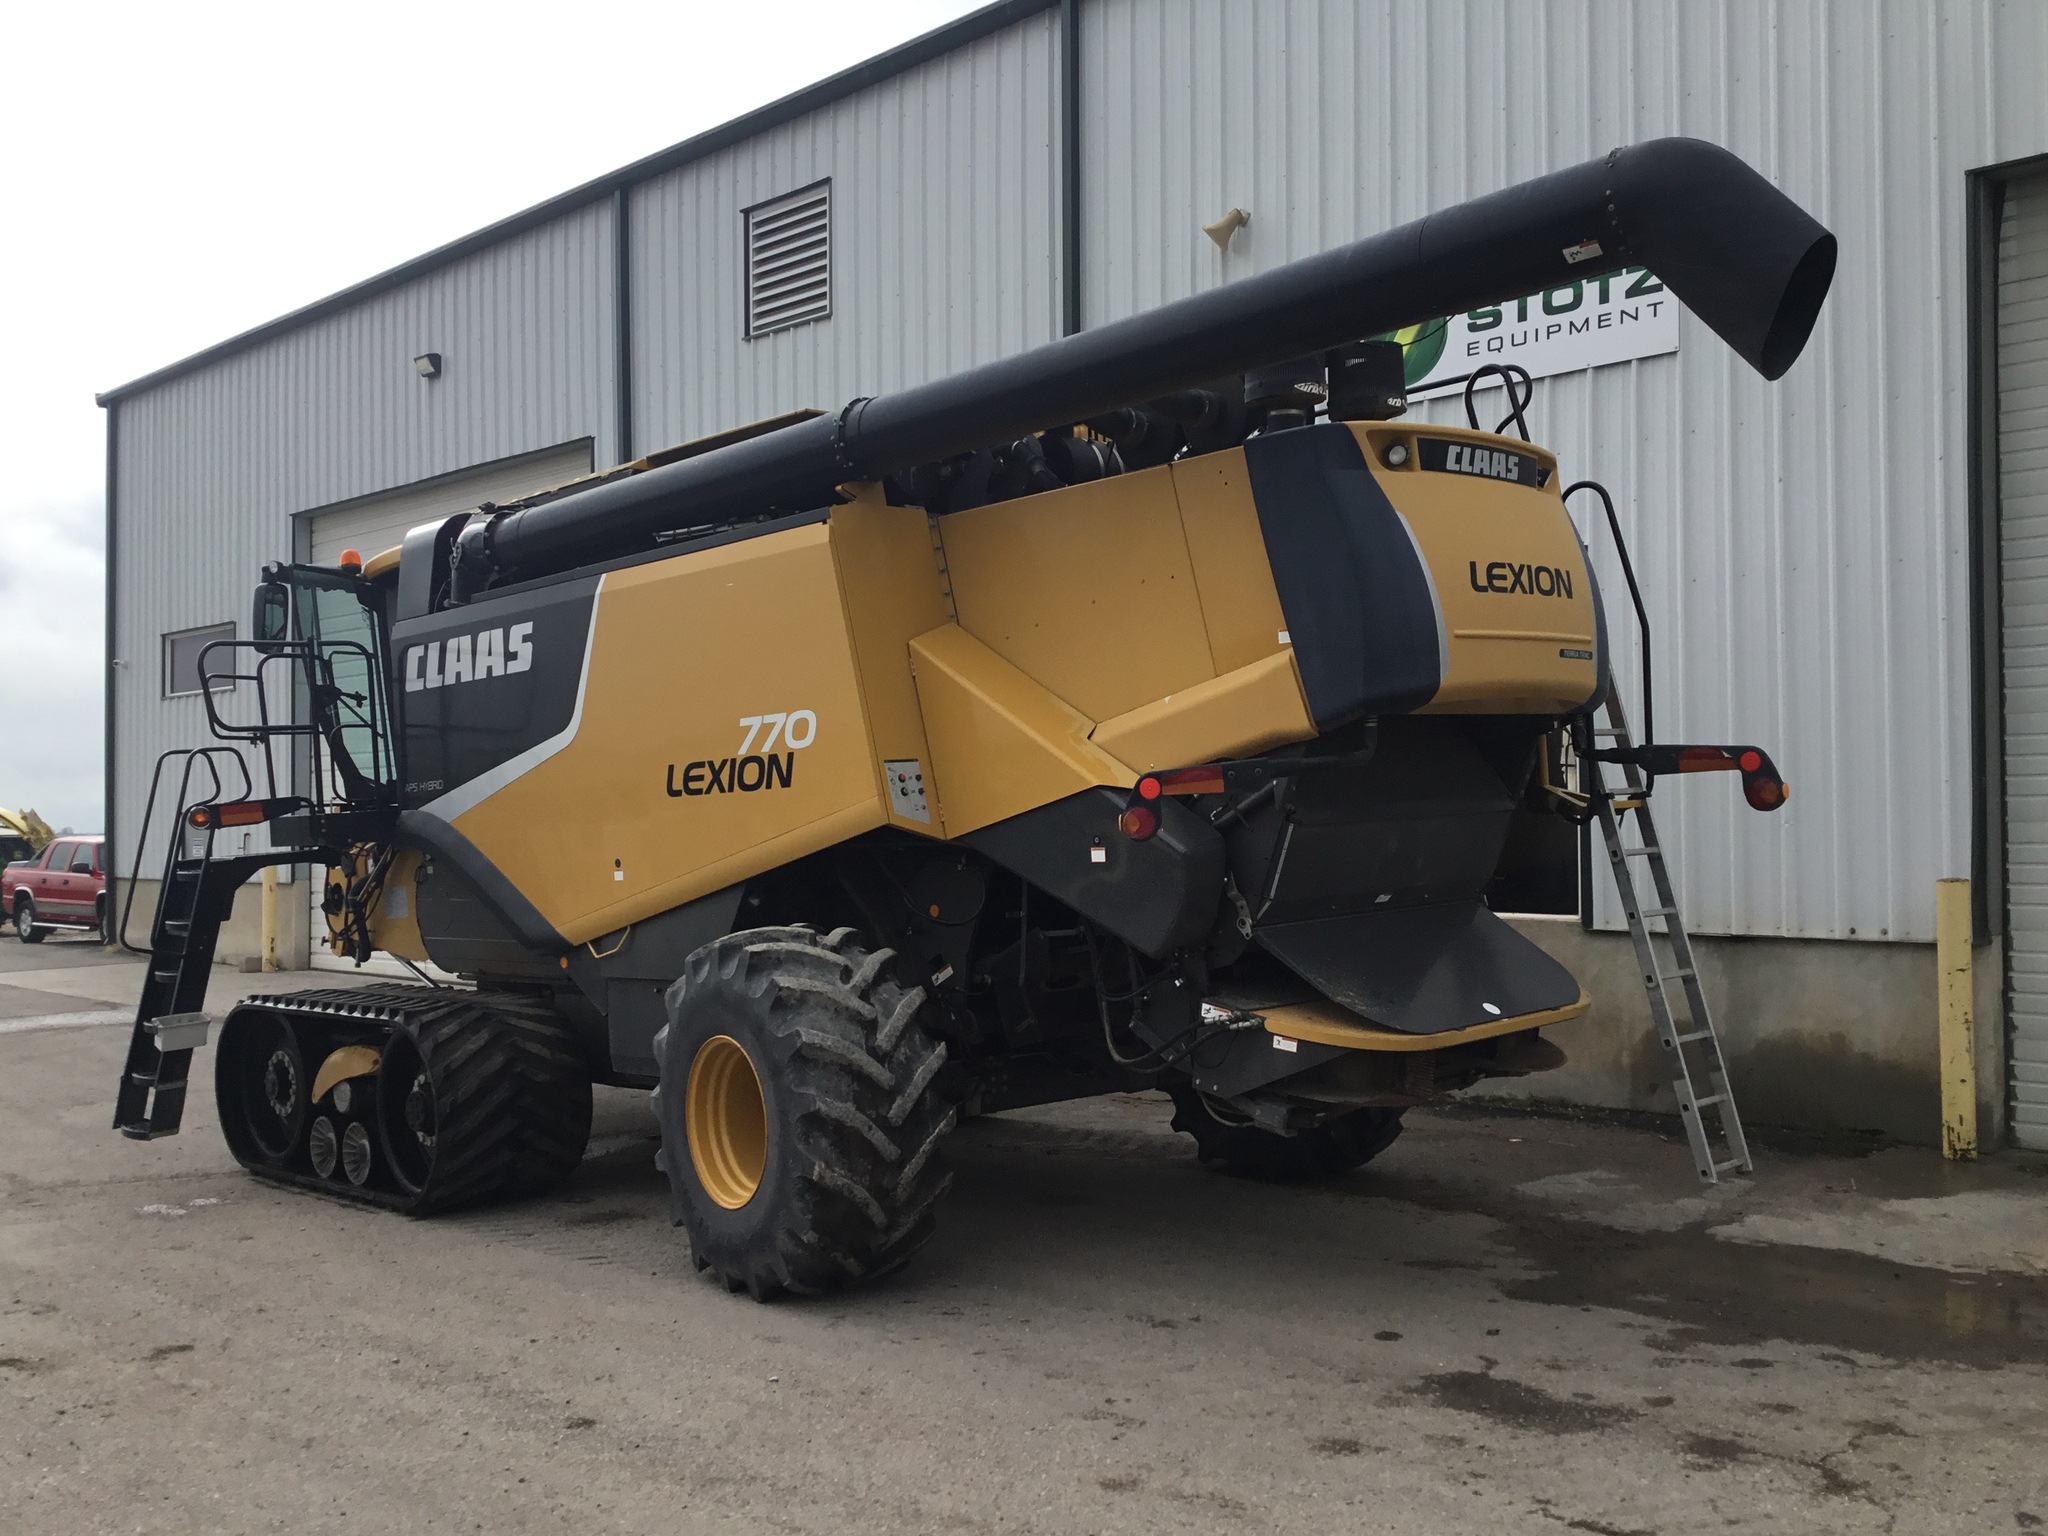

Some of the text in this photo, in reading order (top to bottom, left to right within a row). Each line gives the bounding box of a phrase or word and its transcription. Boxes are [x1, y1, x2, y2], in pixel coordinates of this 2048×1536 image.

[1467, 265, 1664, 333] STOTZ
[1467, 301, 1664, 357] EQUIPMENT
[1446, 445, 1519, 481] CLAAS
[1469, 561, 1573, 600] LEXION
[405, 621, 533, 692] CLAAS
[737, 709, 817, 755] 770
[404, 780, 444, 792] APS HYBRID
[666, 752, 794, 797] LEXION
